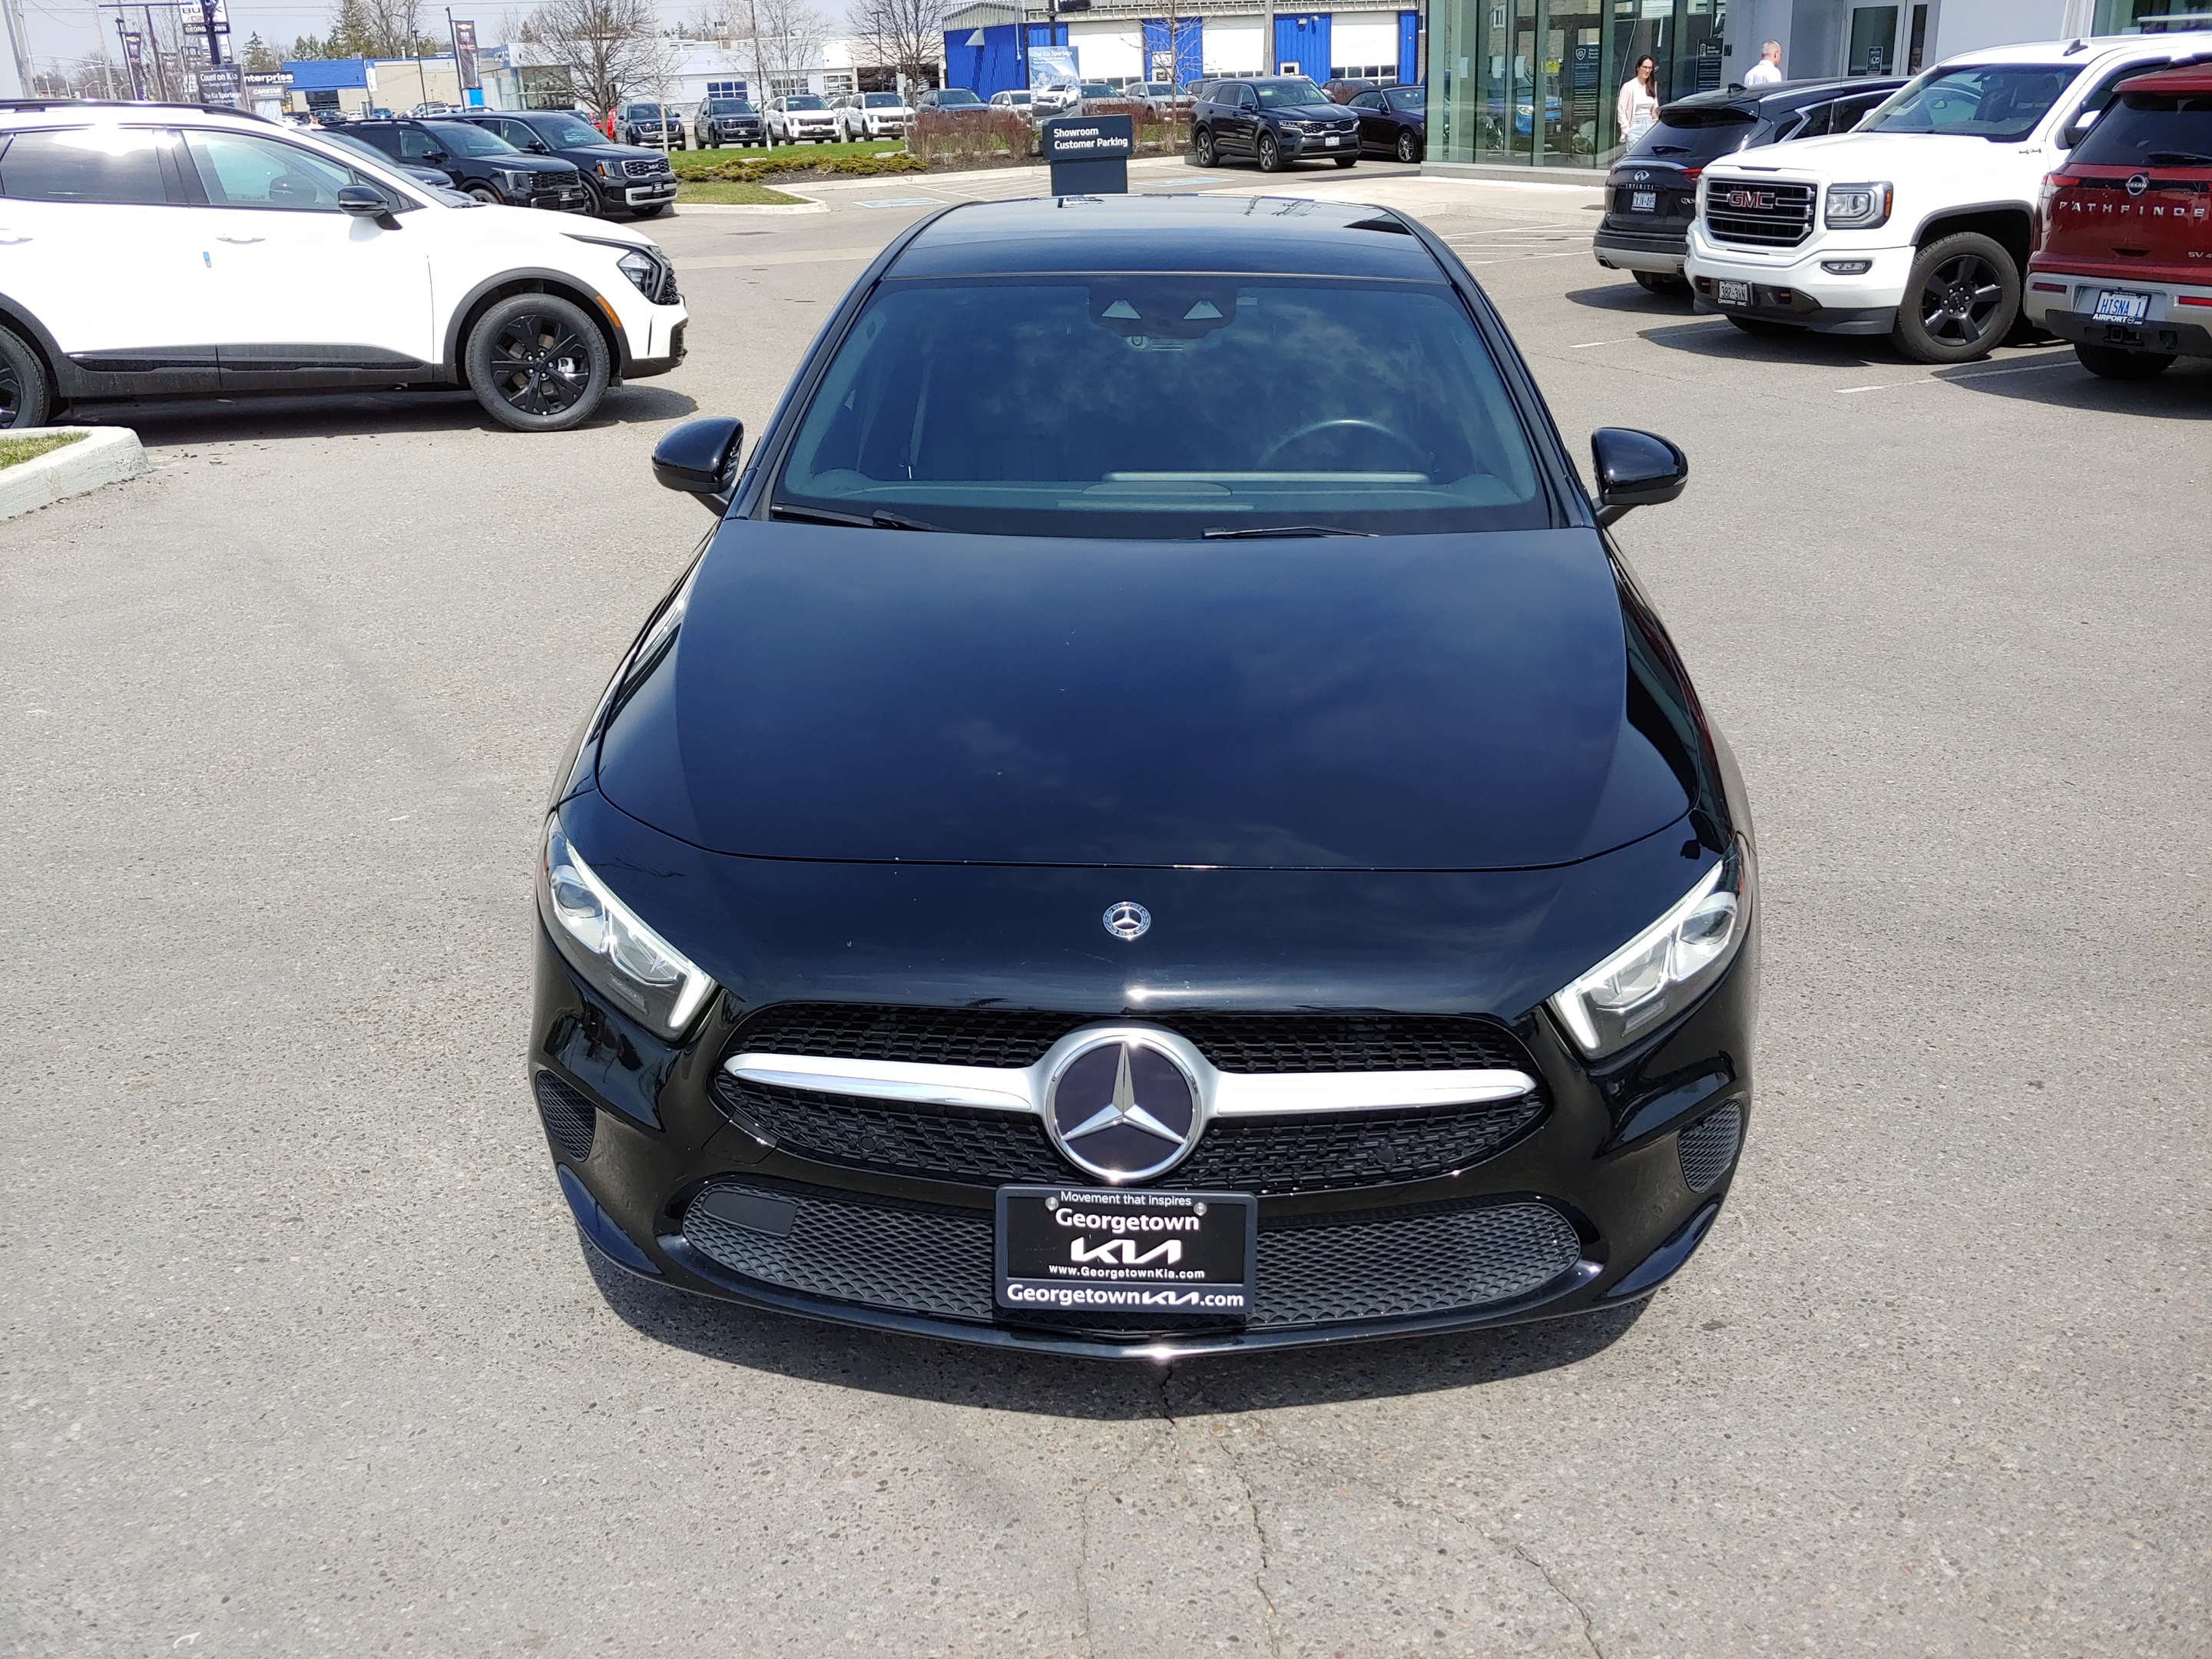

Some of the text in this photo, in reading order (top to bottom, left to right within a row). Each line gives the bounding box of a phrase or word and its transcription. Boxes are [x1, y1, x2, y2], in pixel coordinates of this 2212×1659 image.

[243, 73, 293, 83] nterprise
[1054, 128, 1098, 137] Showroom
[1055, 137, 1128, 150] Customer Parking
[1728, 190, 1775, 210] GMC
[2059, 201, 2205, 217] PATHFINDE
[2101, 298, 2141, 316] HISNA 1
[2092, 313, 2128, 323] AIRPORT
[1061, 1191, 1191, 1207] Movement that inspires
[1055, 1208, 1199, 1233] Georgetown
[1071, 1237, 1181, 1265] KIA
[1048, 1265, 1205, 1280] www.GeorgetownKia.com
